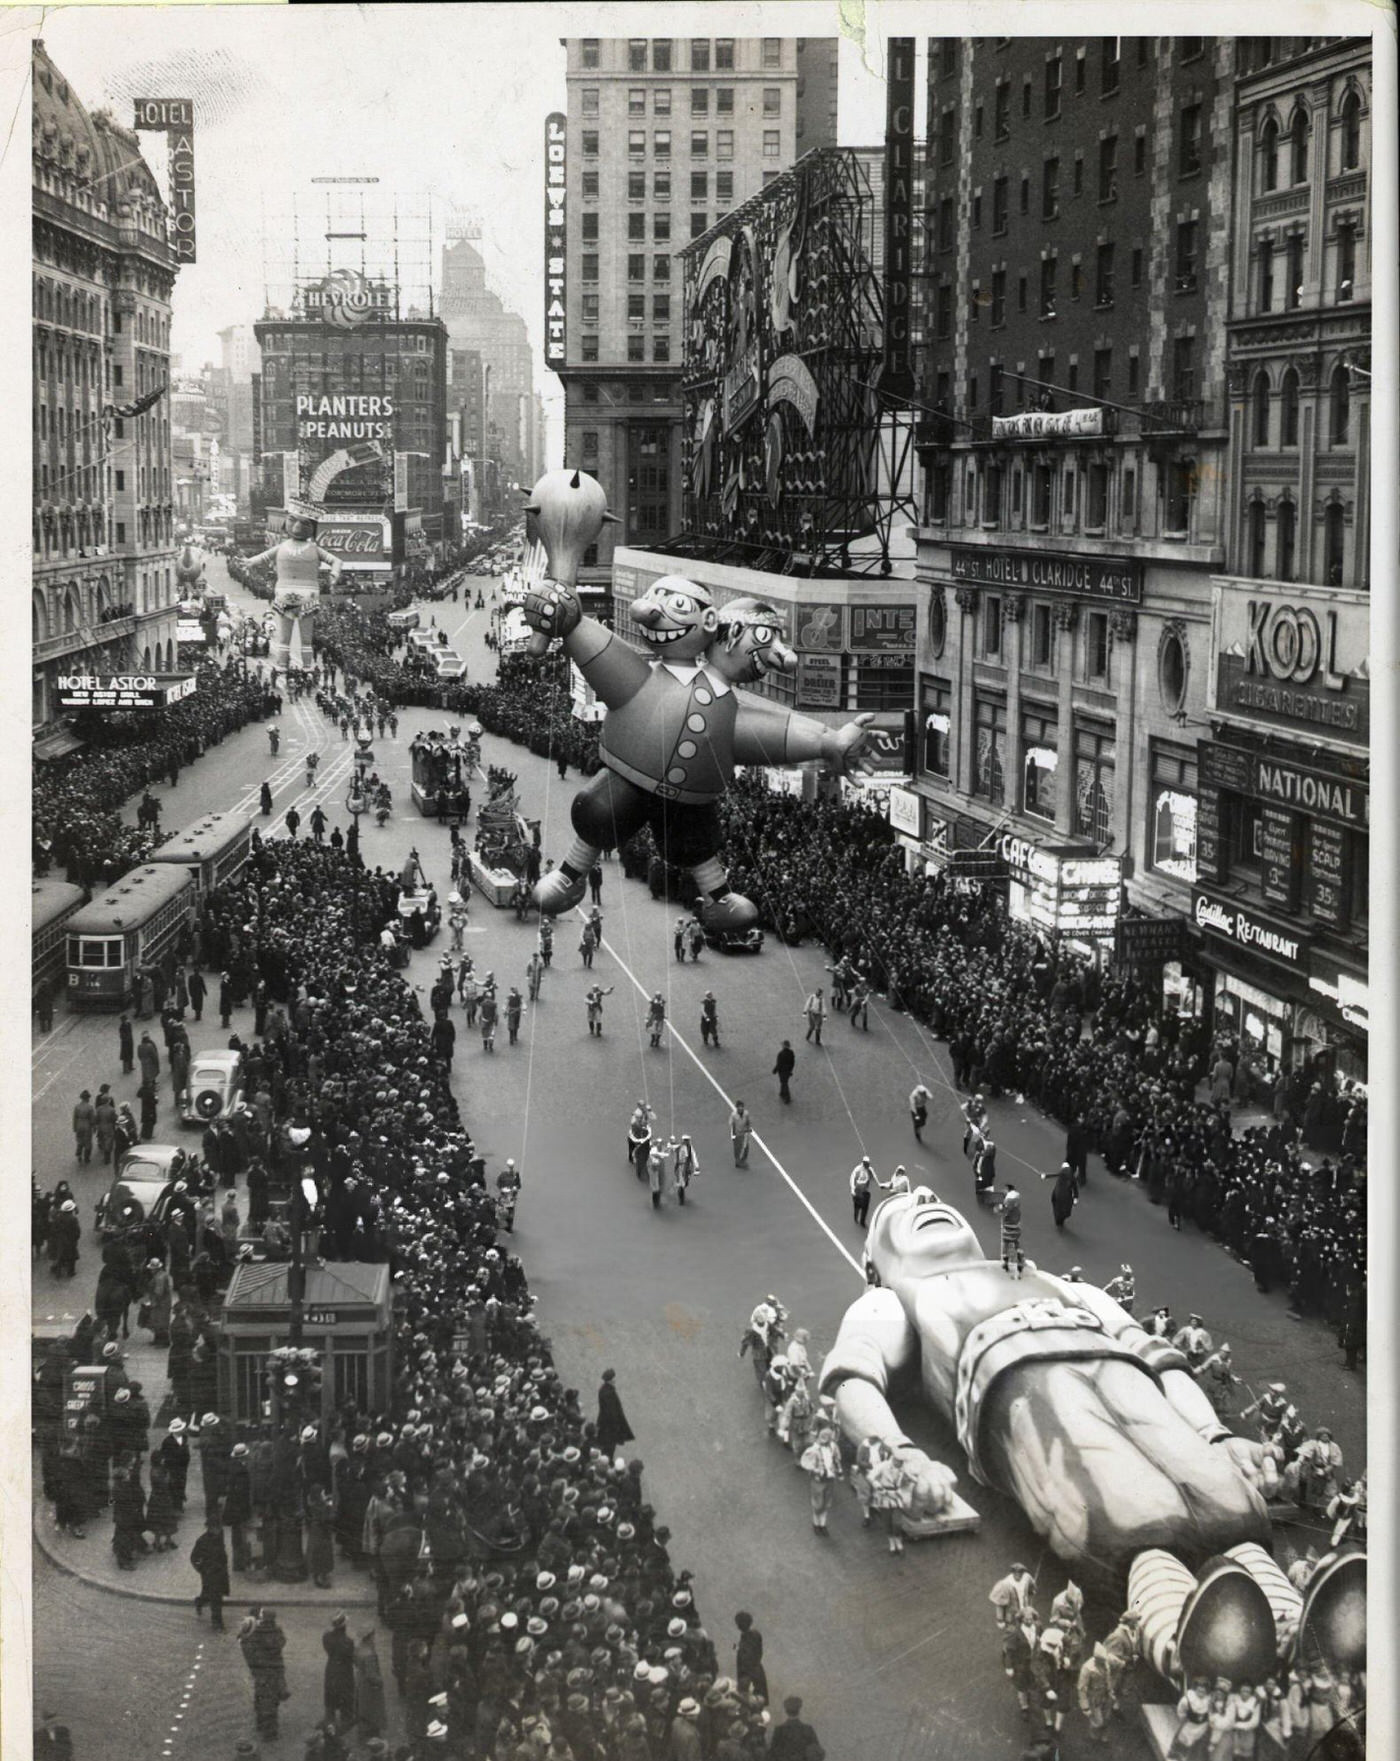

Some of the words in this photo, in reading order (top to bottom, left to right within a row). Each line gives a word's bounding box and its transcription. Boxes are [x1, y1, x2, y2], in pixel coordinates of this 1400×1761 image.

[135, 102, 191, 124] HOTEL
[547, 122, 566, 227] LOEW'S
[175, 136, 195, 257] ASTOR
[891, 105, 910, 375] CLARIDGE
[293, 290, 395, 307] CHEVROLET
[548, 257, 565, 360] STATE
[296, 395, 393, 416] PLANTERS
[306, 421, 384, 438] PEANUTS
[986, 558, 1018, 582] HOTEL
[1032, 560, 1091, 590] CLARIDGE
[1244, 600, 1348, 691] KOOL
[58, 676, 104, 690] HOTEL
[109, 676, 156, 690] ASTOR
[1239, 681, 1358, 730] CIGARETTES
[1259, 763, 1357, 820] NATIONAL
[1311, 849, 1341, 869] SCALP
[1196, 895, 1234, 936] Cadillac
[1236, 913, 1299, 960] RESTAURANT
[68, 974, 80, 986] B
